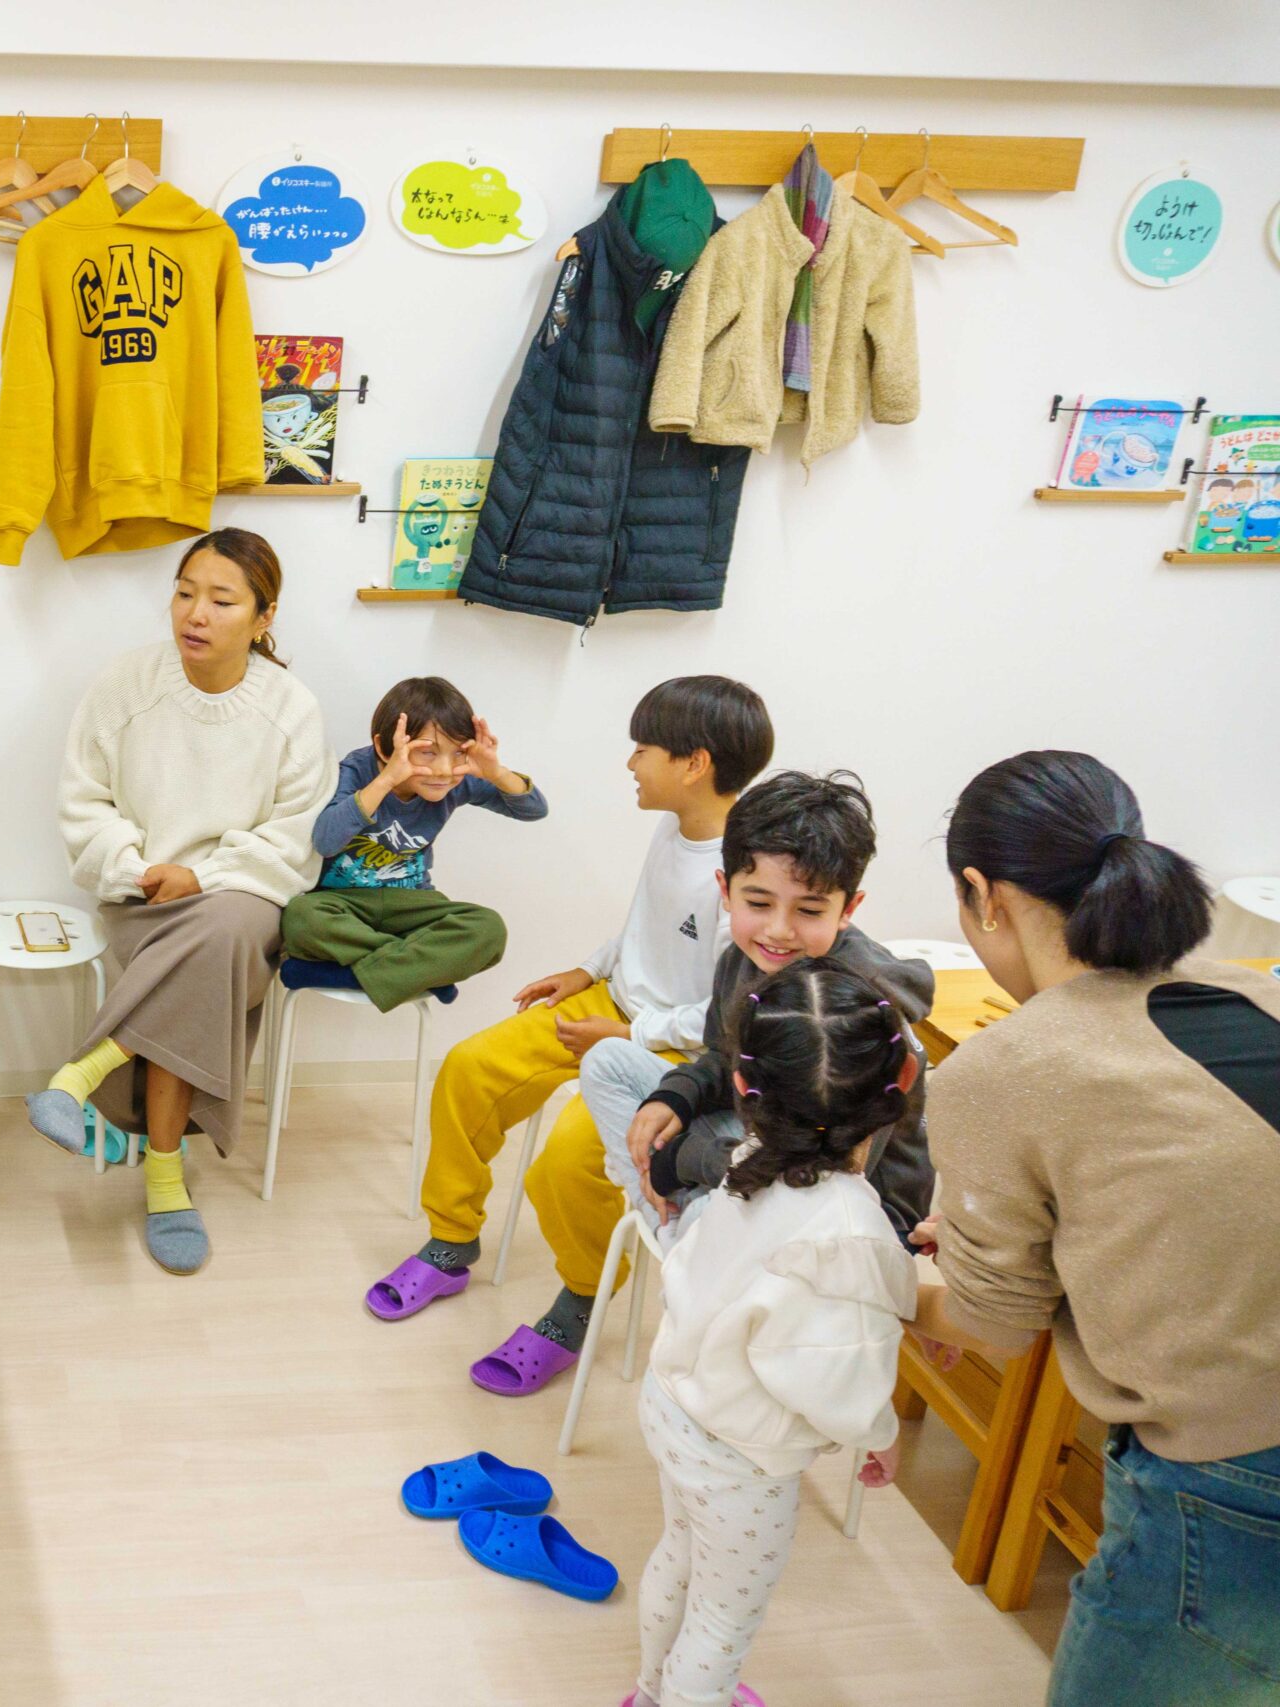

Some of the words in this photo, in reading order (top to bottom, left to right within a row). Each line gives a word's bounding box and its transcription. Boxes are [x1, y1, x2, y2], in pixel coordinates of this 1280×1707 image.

[1155, 194, 1198, 219] ようけ
[72, 244, 183, 339] GAP
[101, 332, 153, 360] 1969
[419, 478, 485, 490] たぬきうどん
